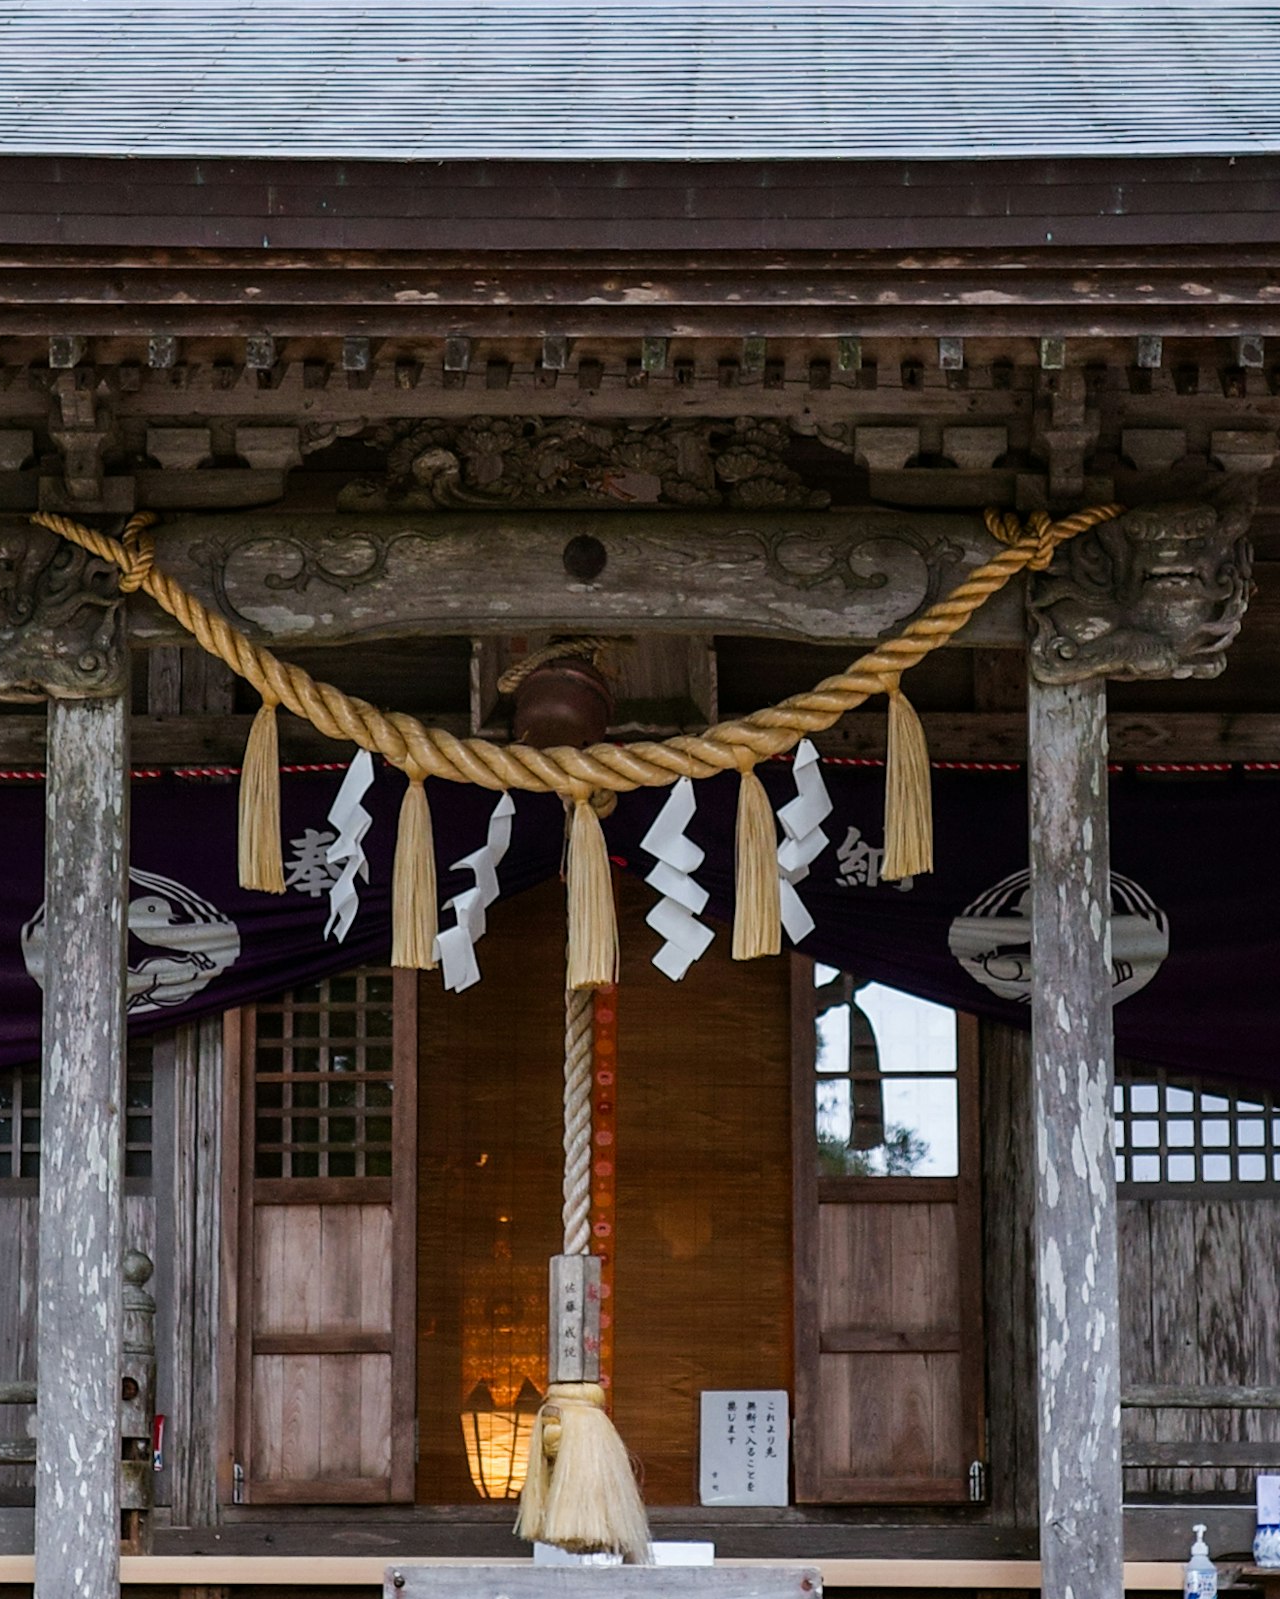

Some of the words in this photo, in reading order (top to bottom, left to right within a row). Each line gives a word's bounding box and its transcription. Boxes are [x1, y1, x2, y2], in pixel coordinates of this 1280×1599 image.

[764, 1401, 778, 1459] これより先
